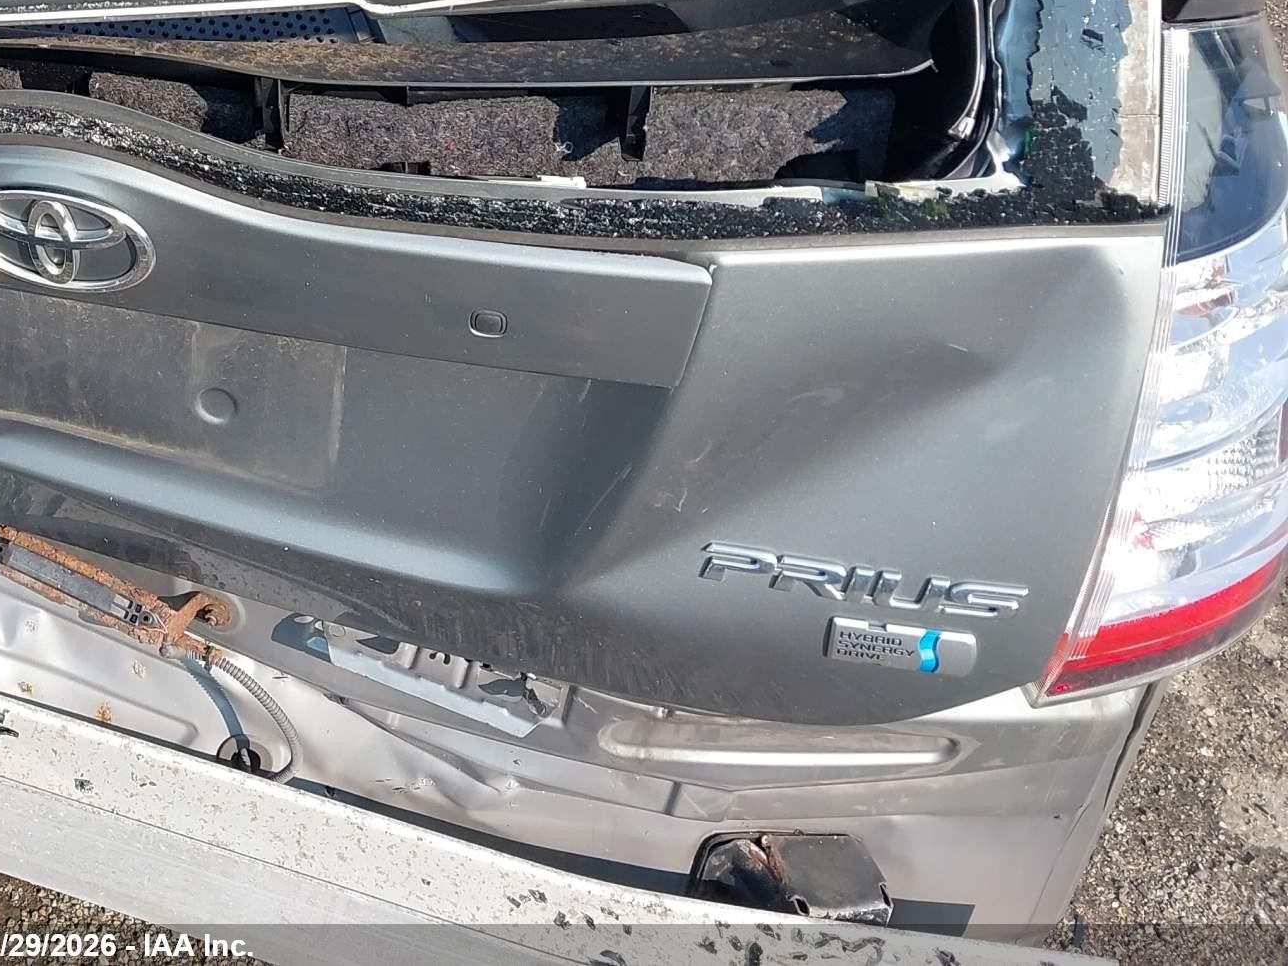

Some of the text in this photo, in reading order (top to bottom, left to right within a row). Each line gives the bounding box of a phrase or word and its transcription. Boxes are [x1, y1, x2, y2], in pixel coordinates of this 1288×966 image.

[698, 542, 1030, 617] PRIUS
[839, 631, 903, 647] HYBRID
[836, 648, 886, 662] DRIVE
[837, 639, 916, 657] SYNERGY
